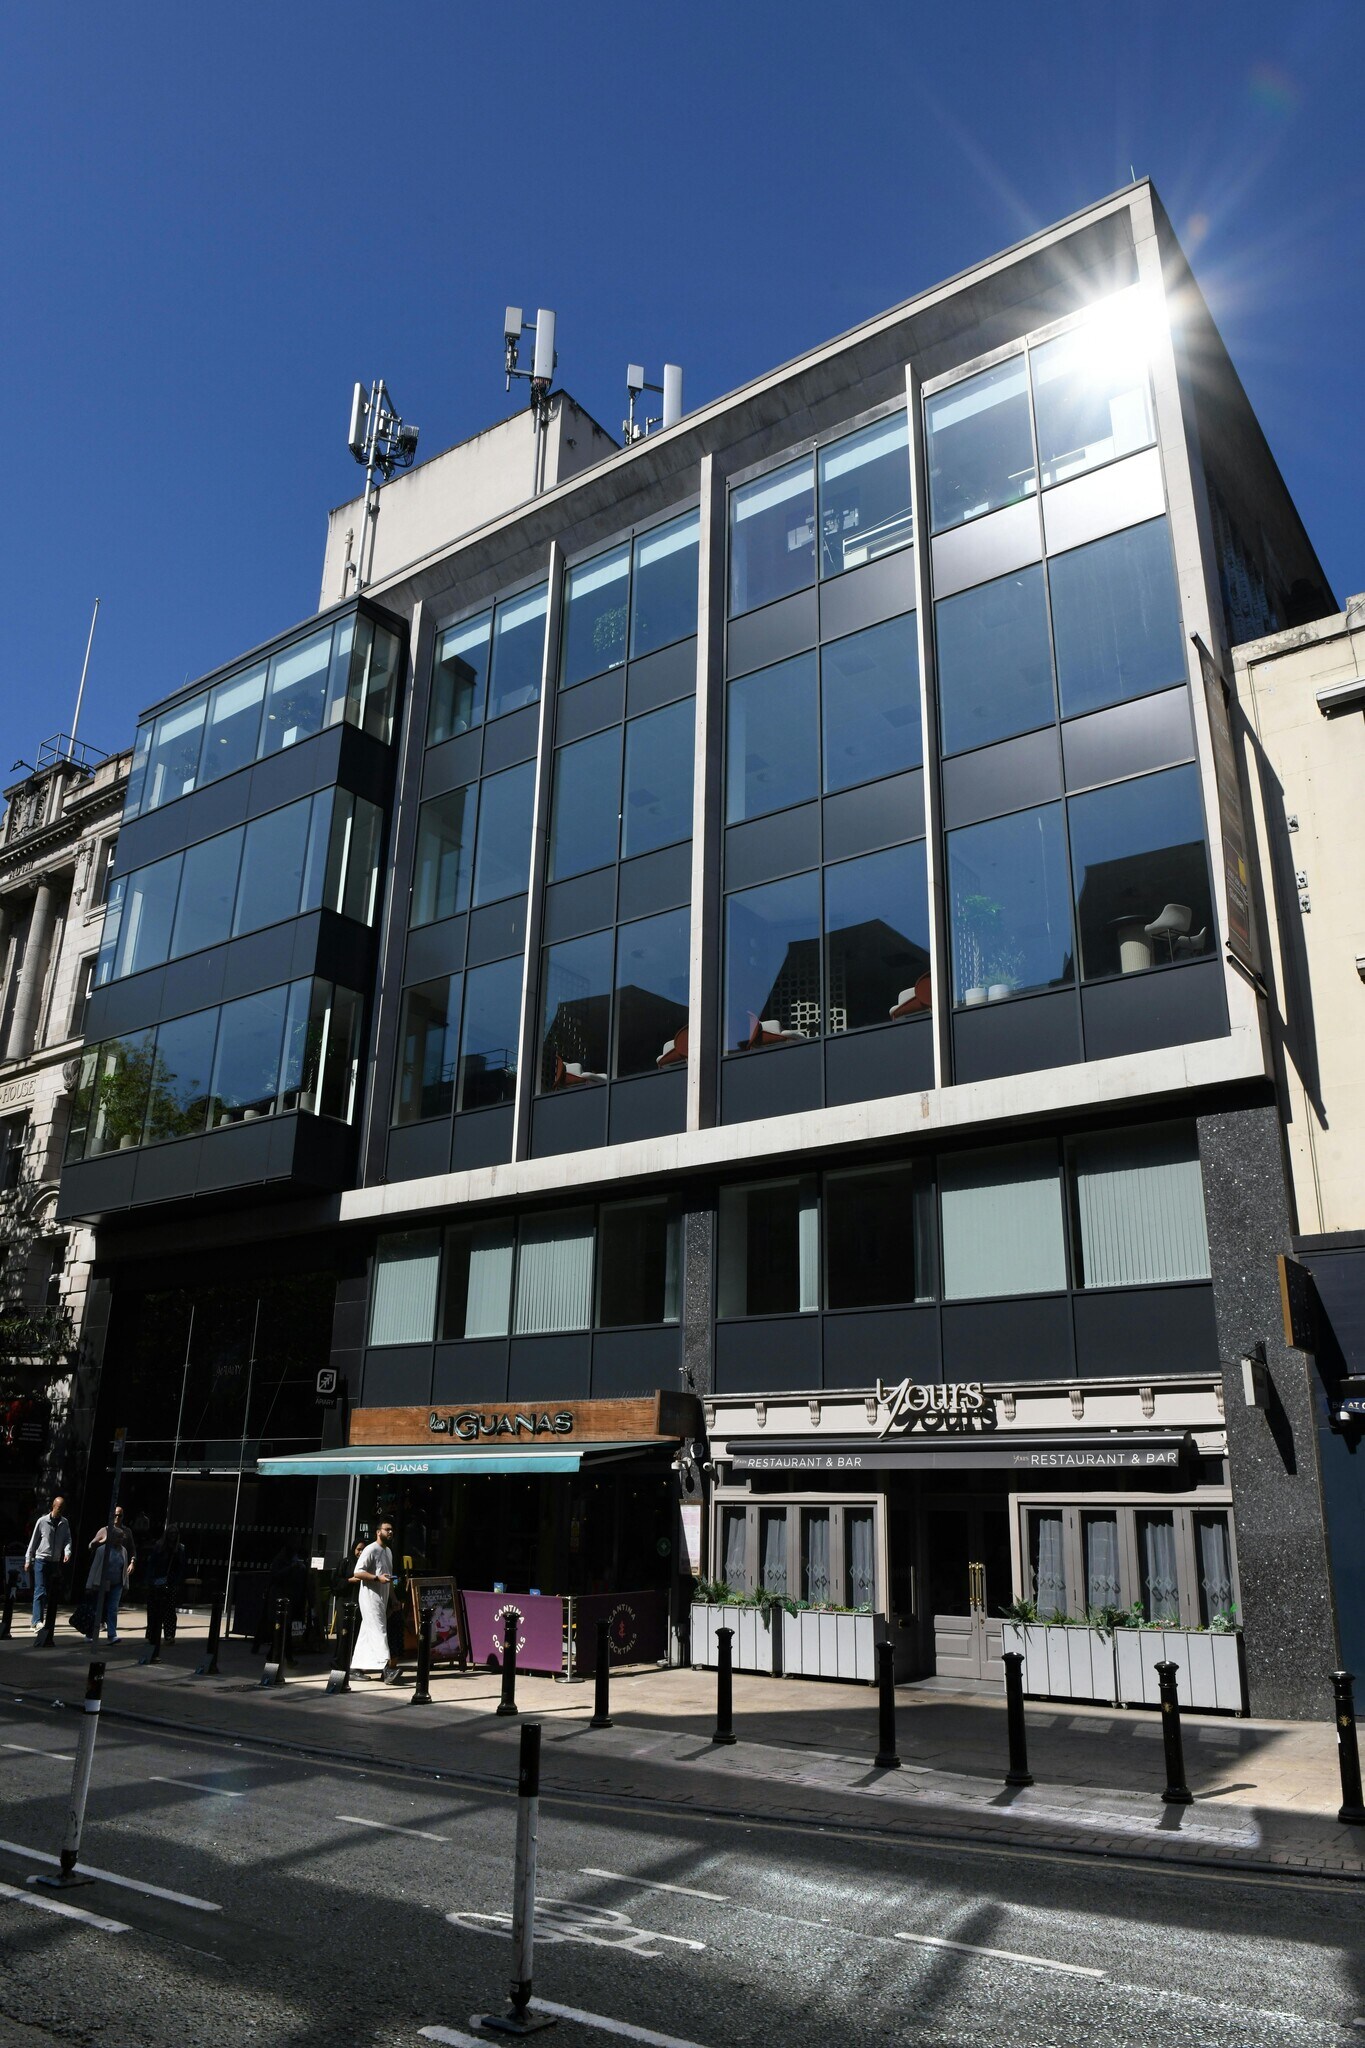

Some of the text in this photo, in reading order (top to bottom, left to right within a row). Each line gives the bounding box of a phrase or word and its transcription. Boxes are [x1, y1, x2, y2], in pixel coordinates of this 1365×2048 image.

[2, 1079, 37, 1104] HOUSE
[447, 1411, 574, 1441] IGUANAS
[384, 1463, 429, 1473] IGUANAS
[747, 1456, 822, 1468] RESTAURANT
[825, 1457, 833, 1467] &
[837, 1457, 862, 1467] BAR
[1031, 1453, 1125, 1465] RESTAURANT
[1131, 1453, 1140, 1464] &
[1146, 1452, 1177, 1464] BAR
[494, 1604, 525, 1625] CANTINA
[608, 1603, 636, 1623] CANTINA
